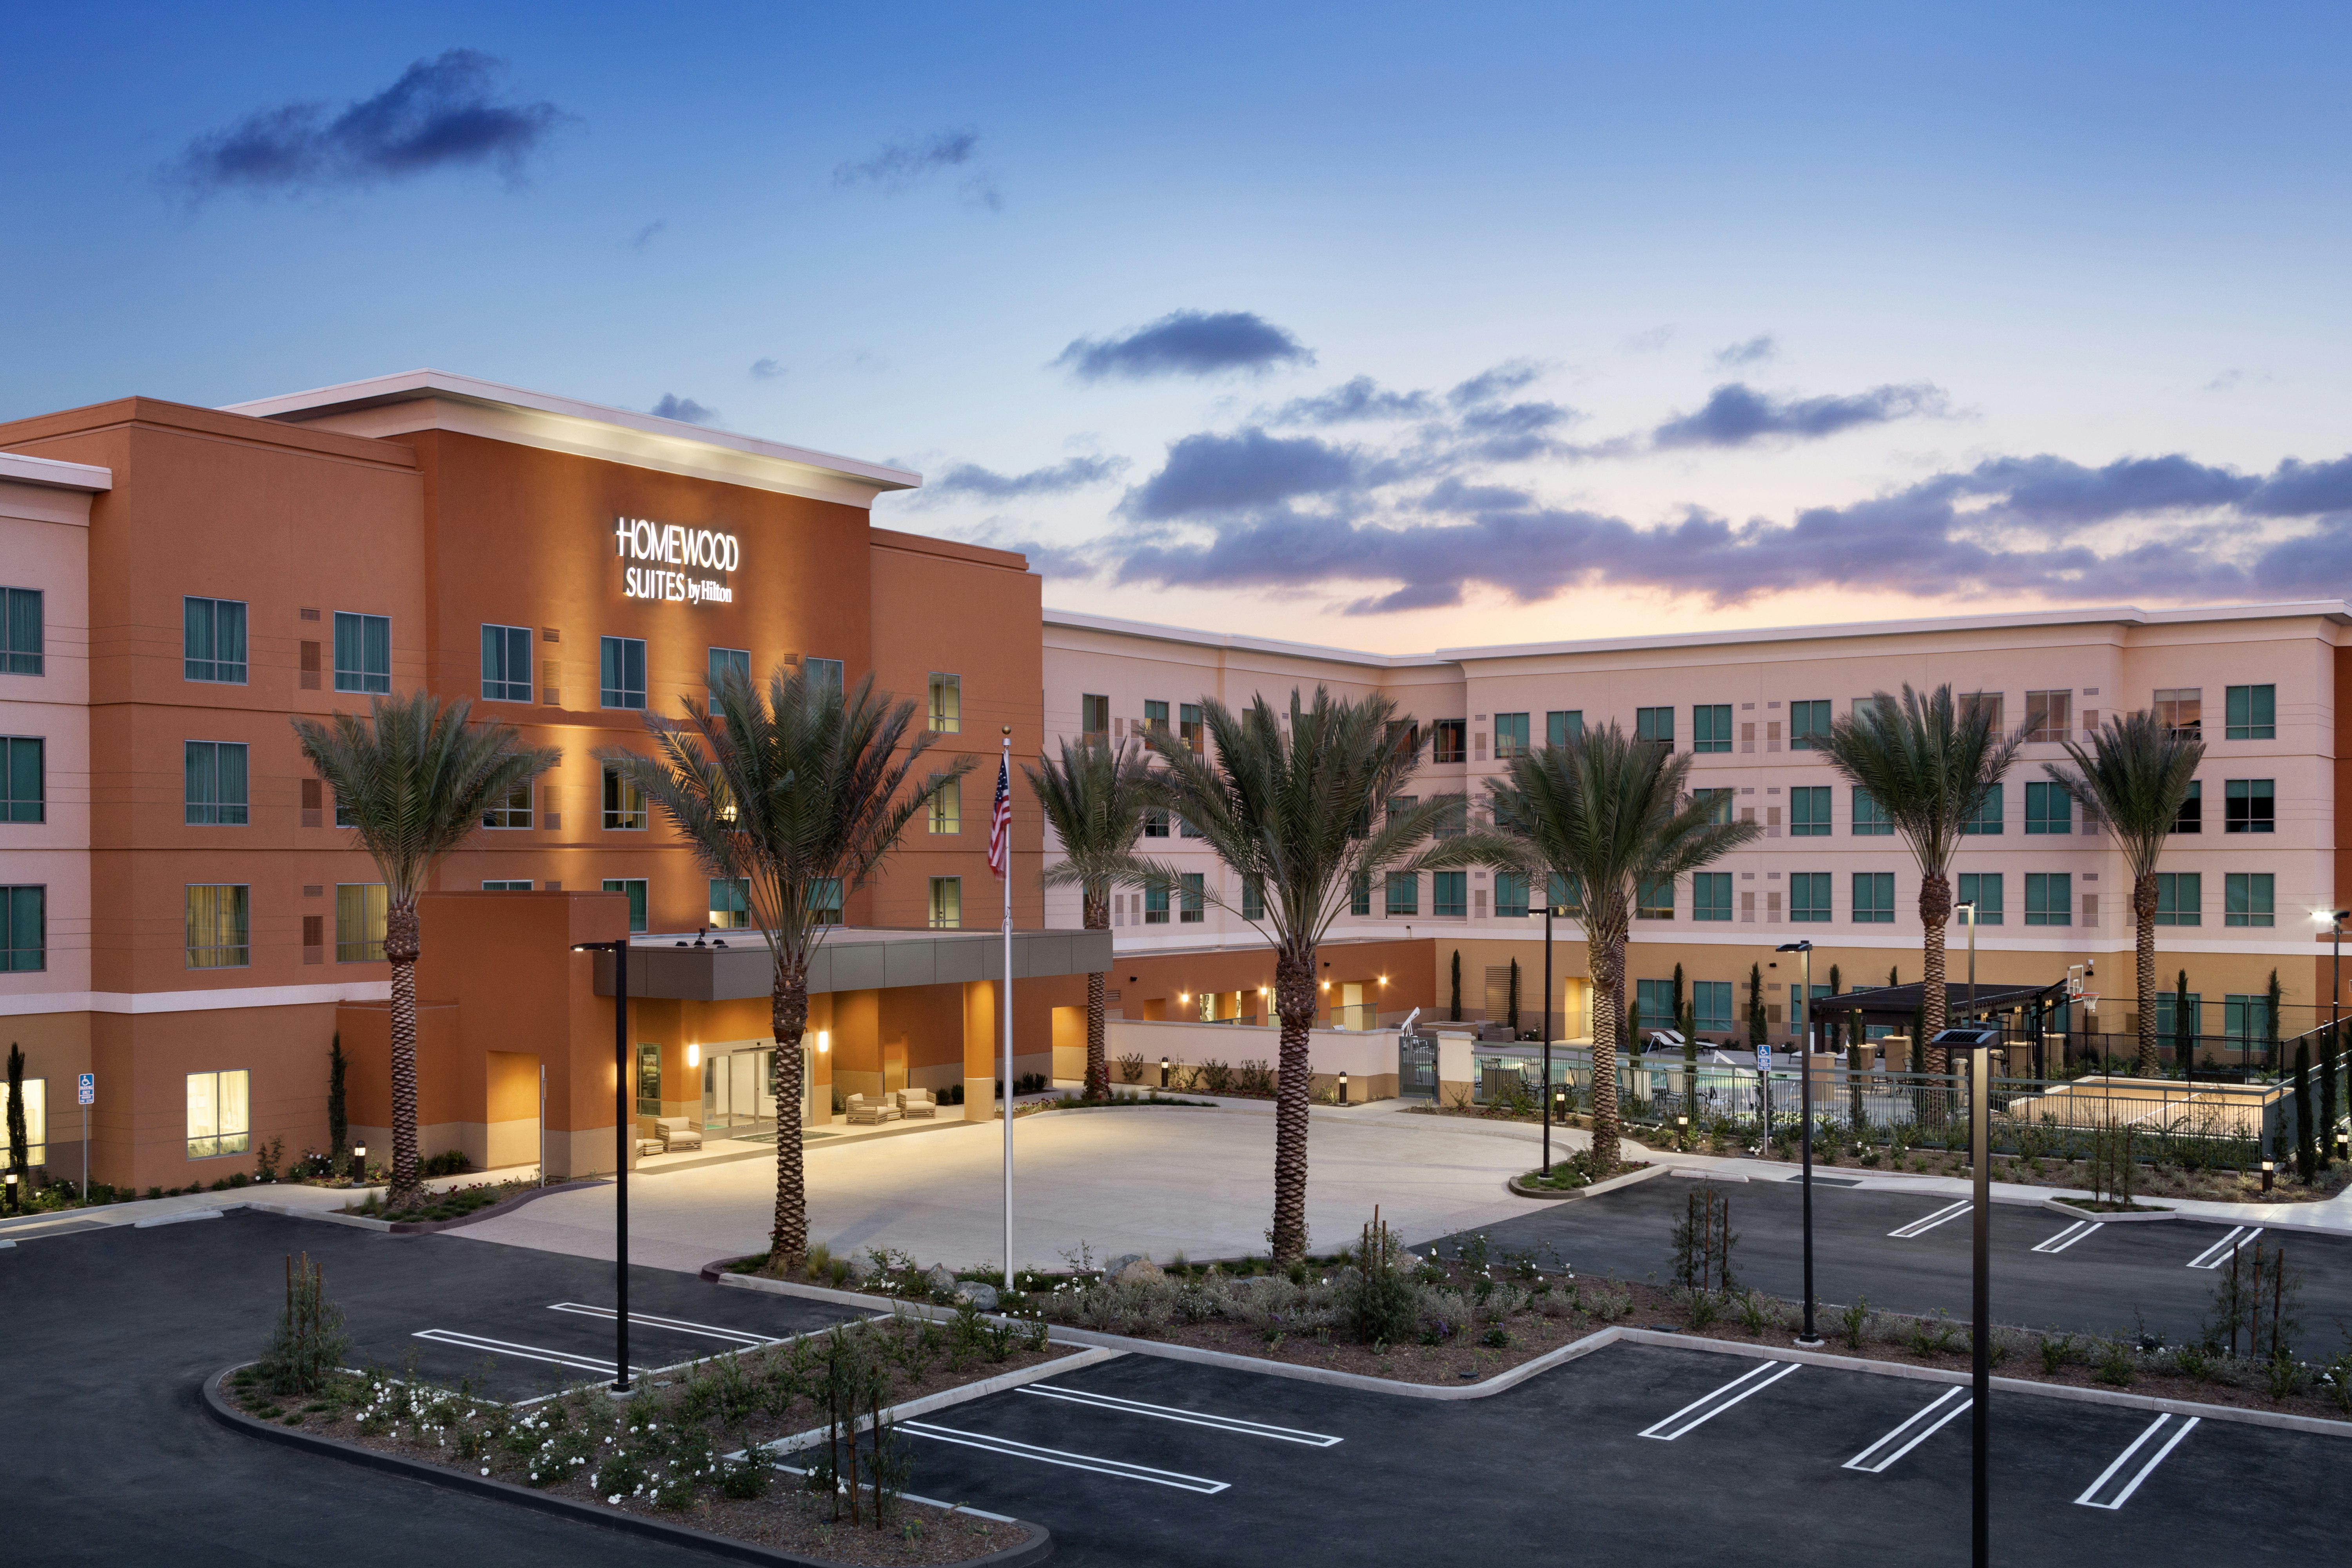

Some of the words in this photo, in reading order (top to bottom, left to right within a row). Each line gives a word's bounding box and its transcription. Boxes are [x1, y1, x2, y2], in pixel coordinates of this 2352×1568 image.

[616, 517, 738, 572] HOMEWOOD
[626, 567, 685, 601] SUITES
[687, 578, 701, 605] by
[701, 580, 732, 603] Hilton
